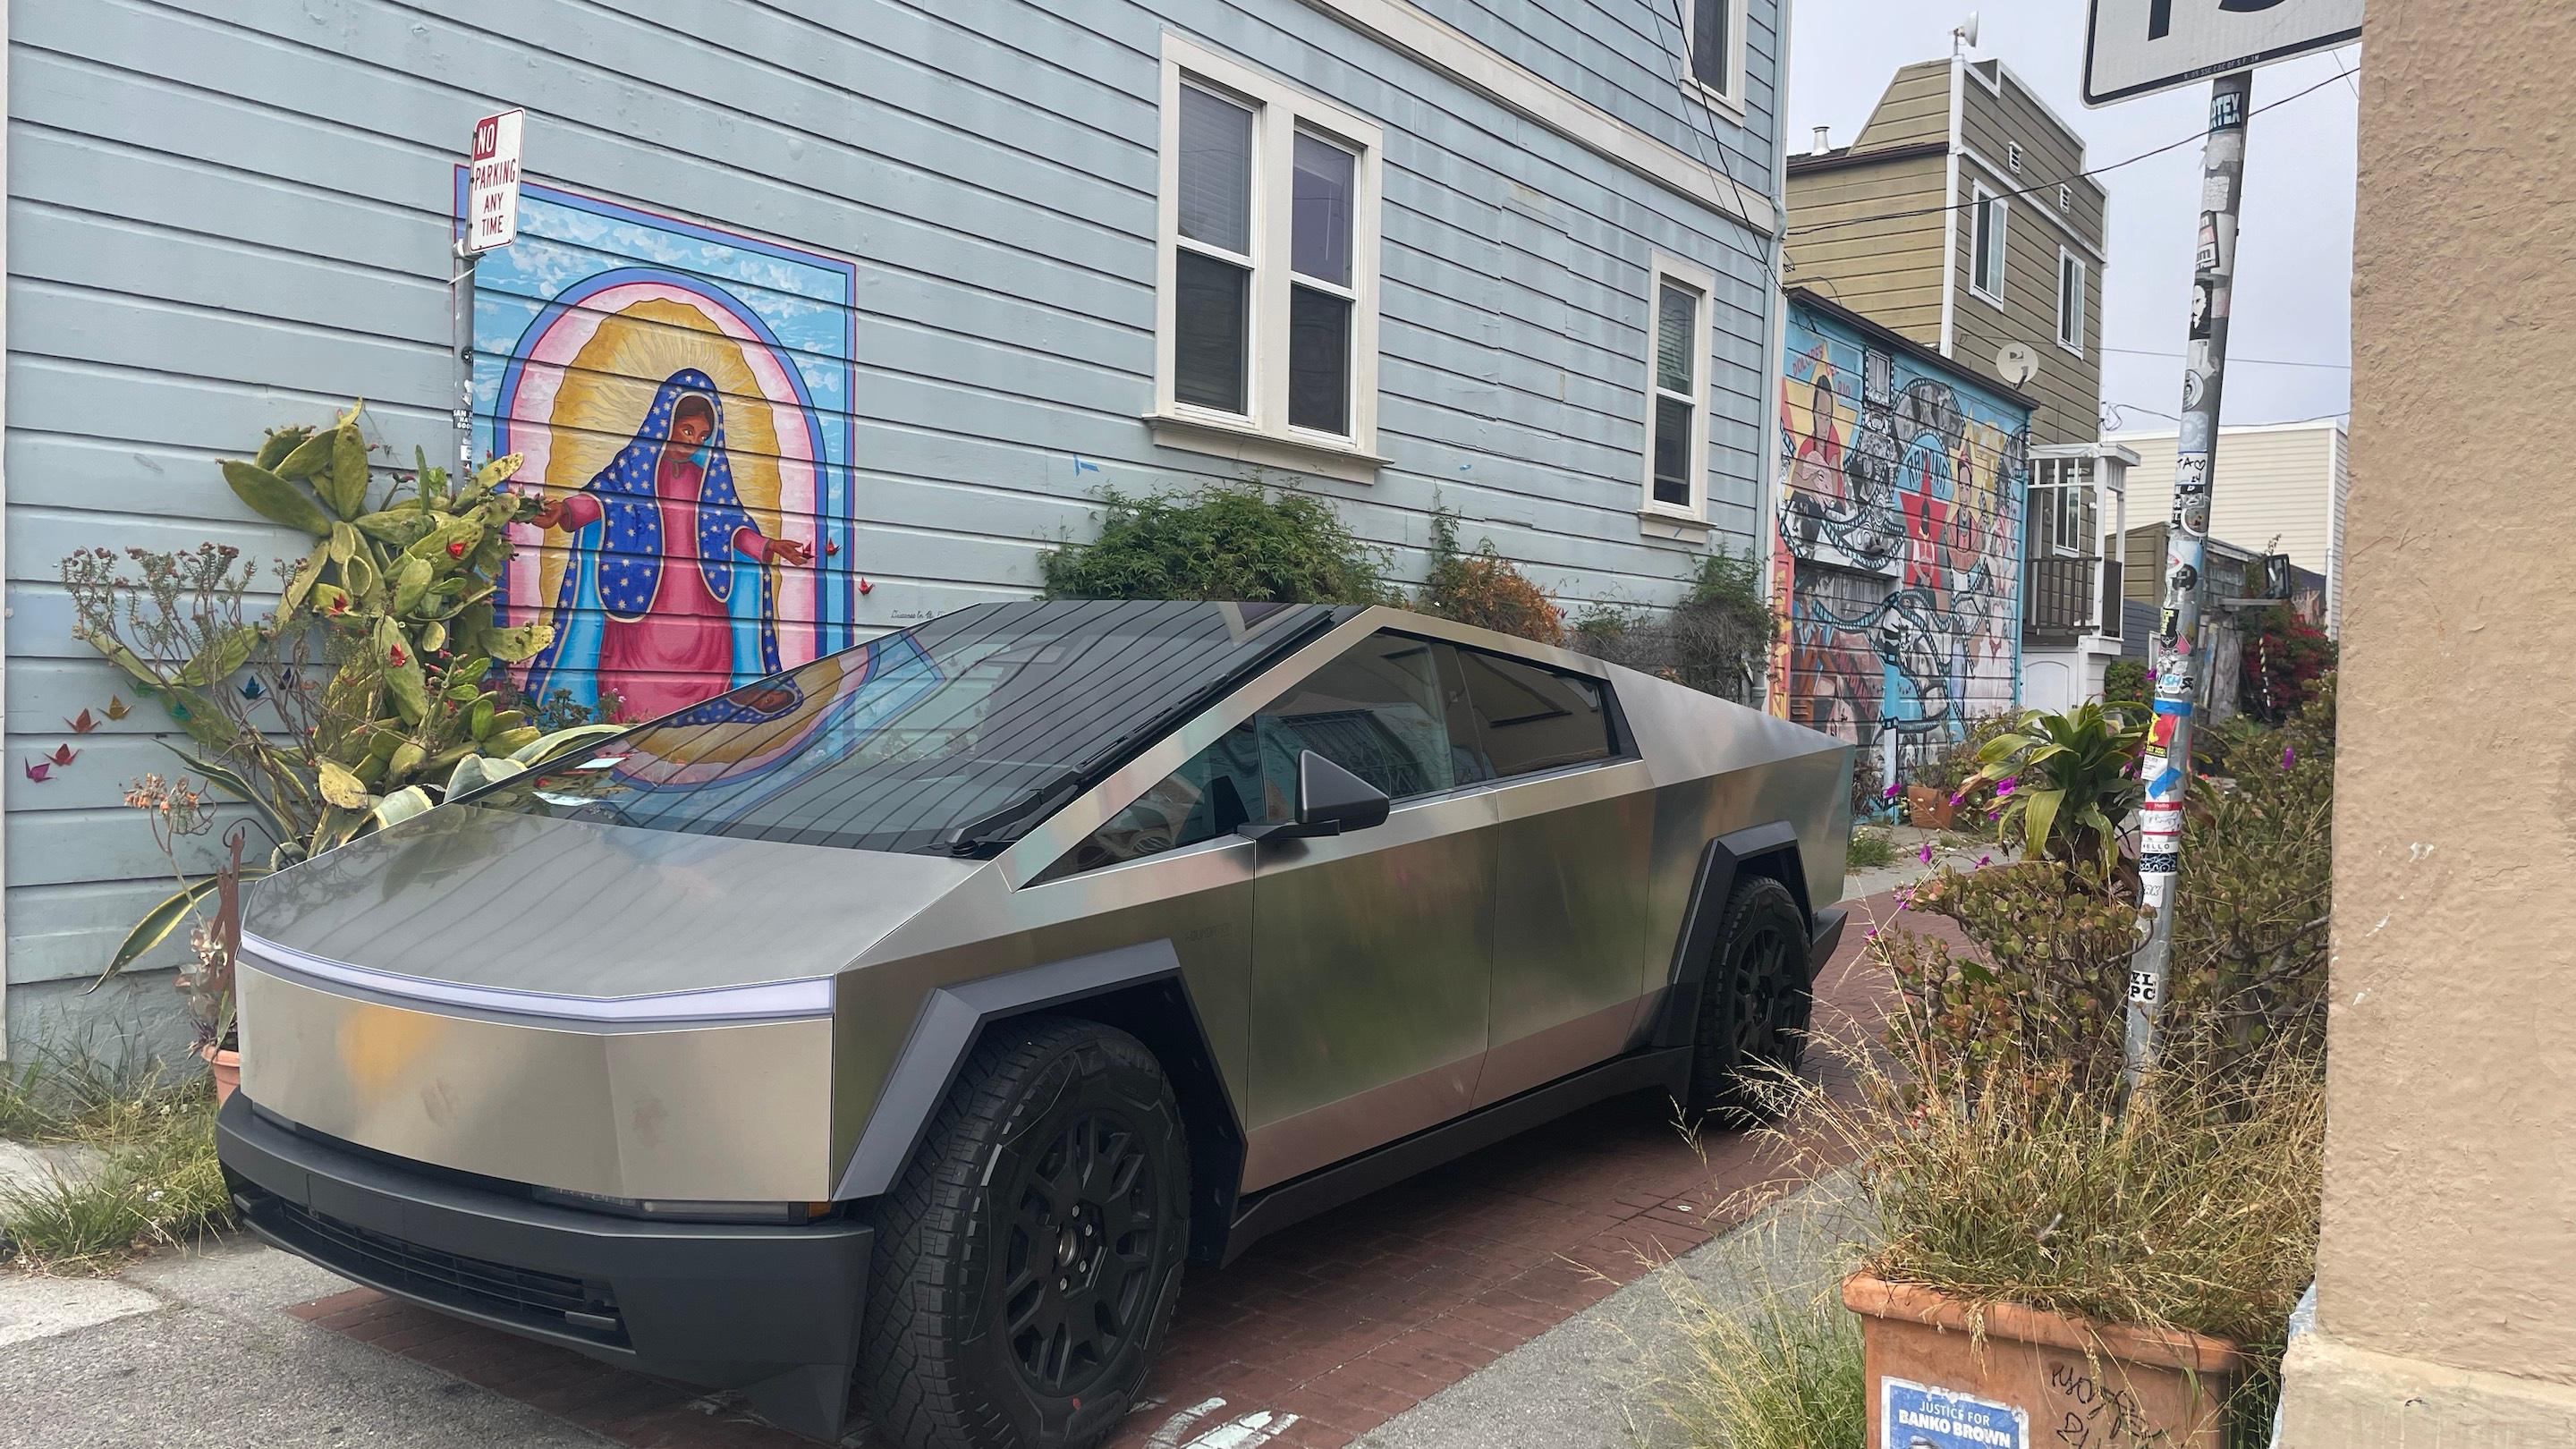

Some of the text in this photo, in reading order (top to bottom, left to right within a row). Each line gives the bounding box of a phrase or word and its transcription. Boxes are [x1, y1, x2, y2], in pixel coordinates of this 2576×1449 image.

[477, 123, 496, 156] NO
[474, 158, 516, 191] PARKING
[484, 192, 504, 214] ANY
[482, 215, 504, 237] TIME
[1899, 1409, 2011, 1448] BANKO BROWN
[1919, 1401, 1990, 1427] JUSTICE FOR
